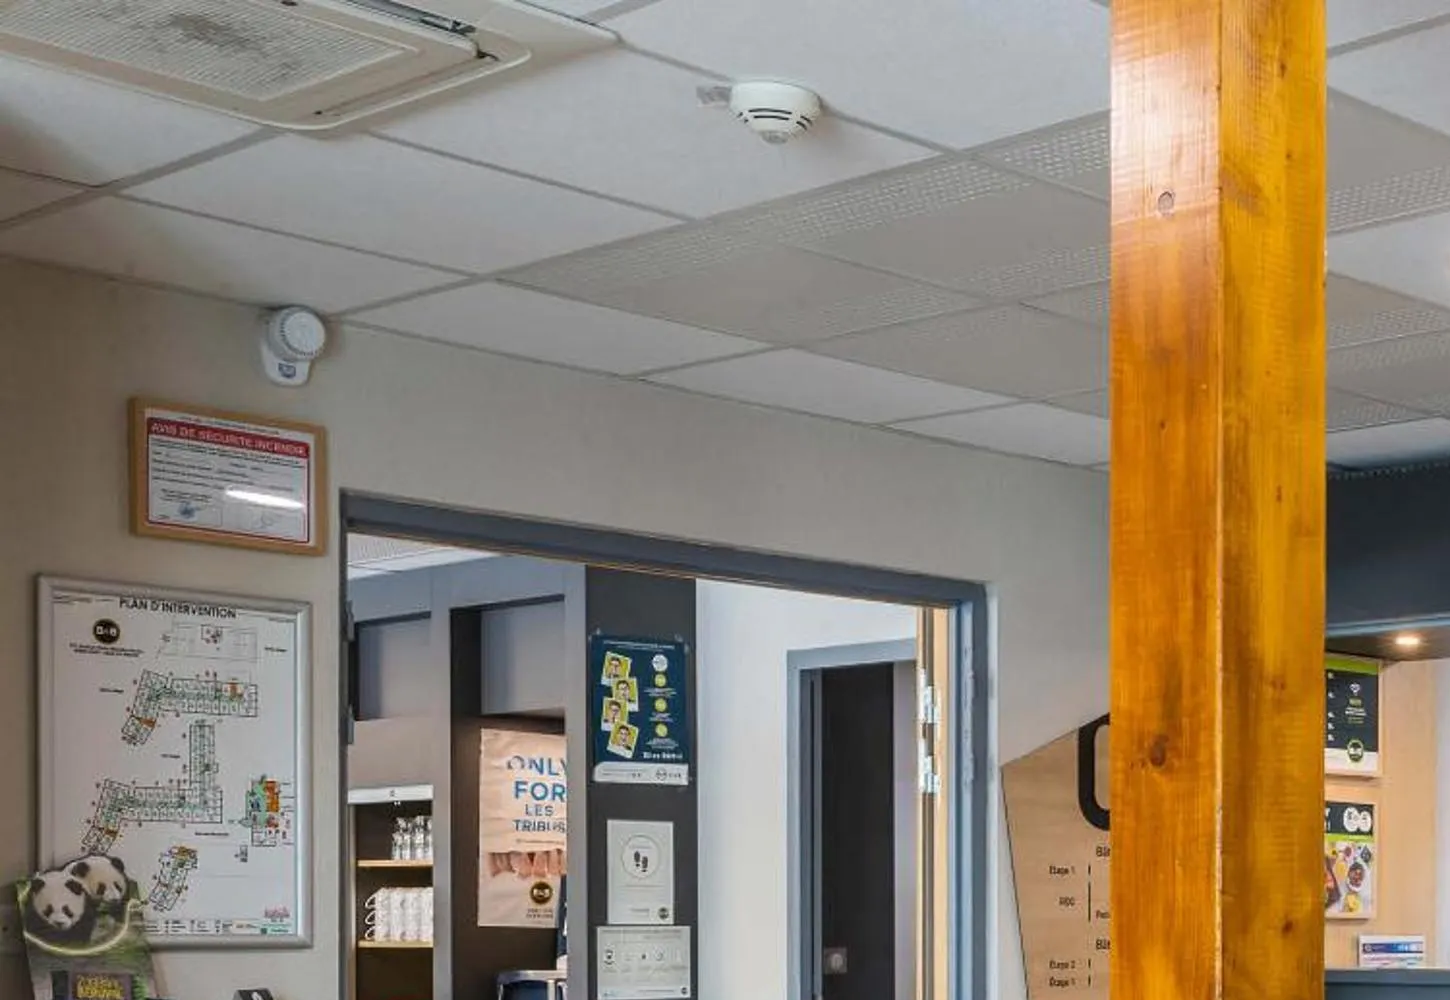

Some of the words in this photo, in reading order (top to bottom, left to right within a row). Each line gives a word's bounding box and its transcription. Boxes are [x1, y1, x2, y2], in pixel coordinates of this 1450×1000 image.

[179, 426, 197, 438] DE
[119, 597, 148, 611] PLAN
[514, 780, 567, 802] FOR
[525, 803, 555, 817] LES
